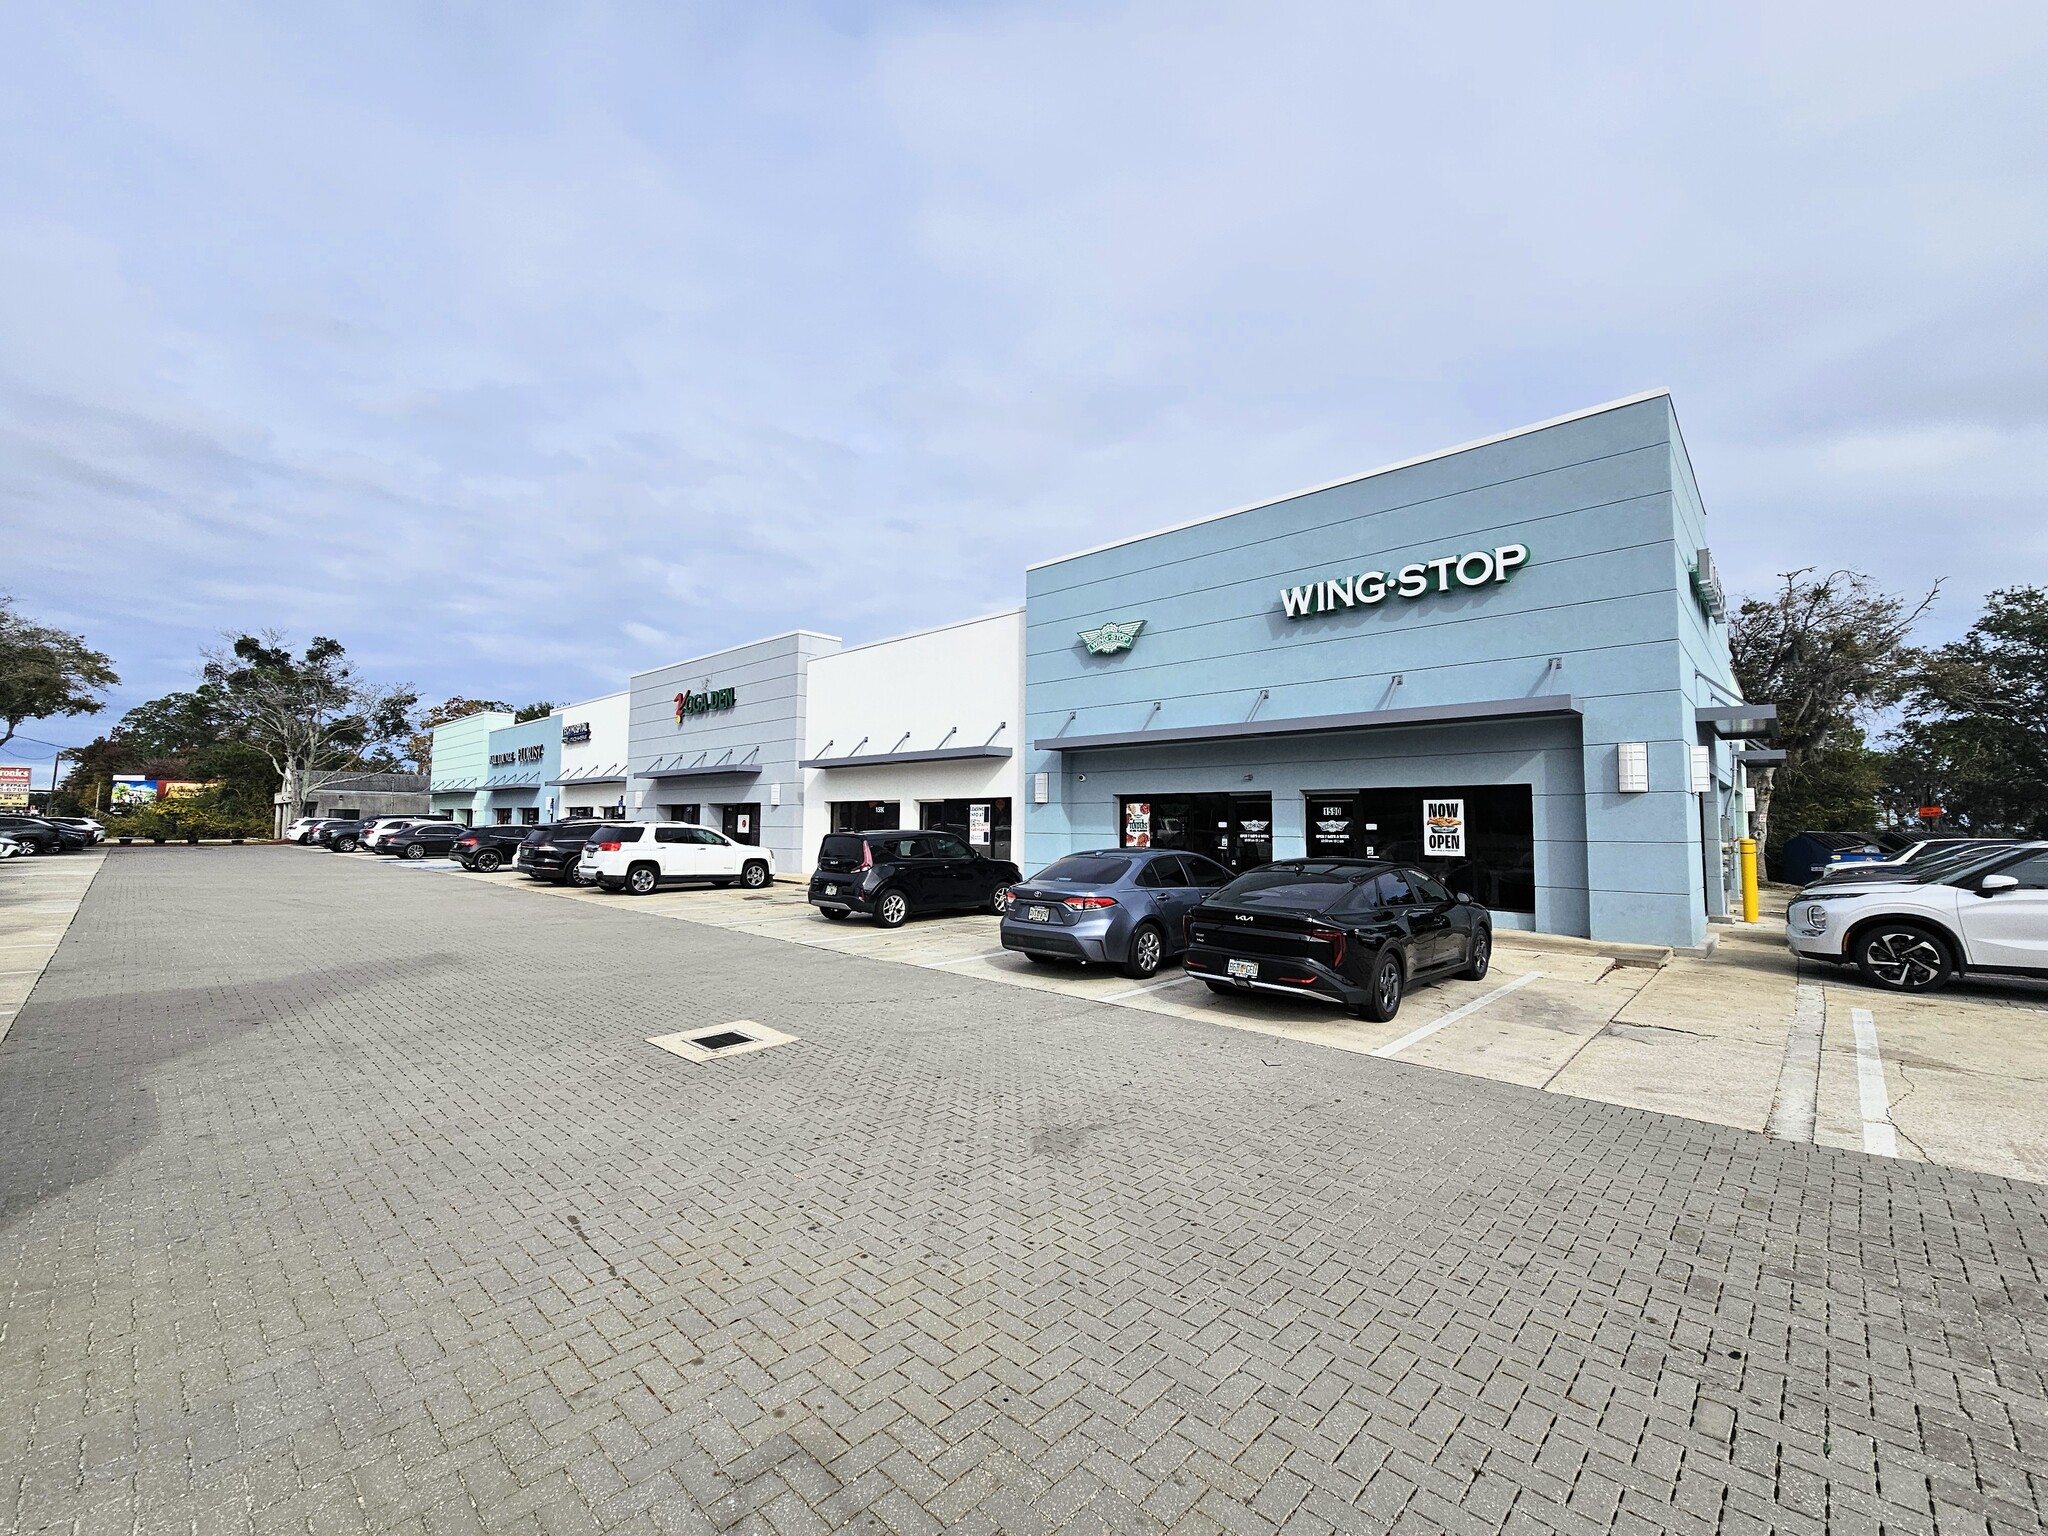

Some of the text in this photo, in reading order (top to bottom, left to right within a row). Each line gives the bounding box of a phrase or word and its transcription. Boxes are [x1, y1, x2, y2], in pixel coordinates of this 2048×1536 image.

[674, 687, 735, 716] YOGA DEN
[1323, 807, 1342, 816] 1590
[1428, 803, 1459, 818] NOW
[1429, 834, 1460, 850] OPEN
